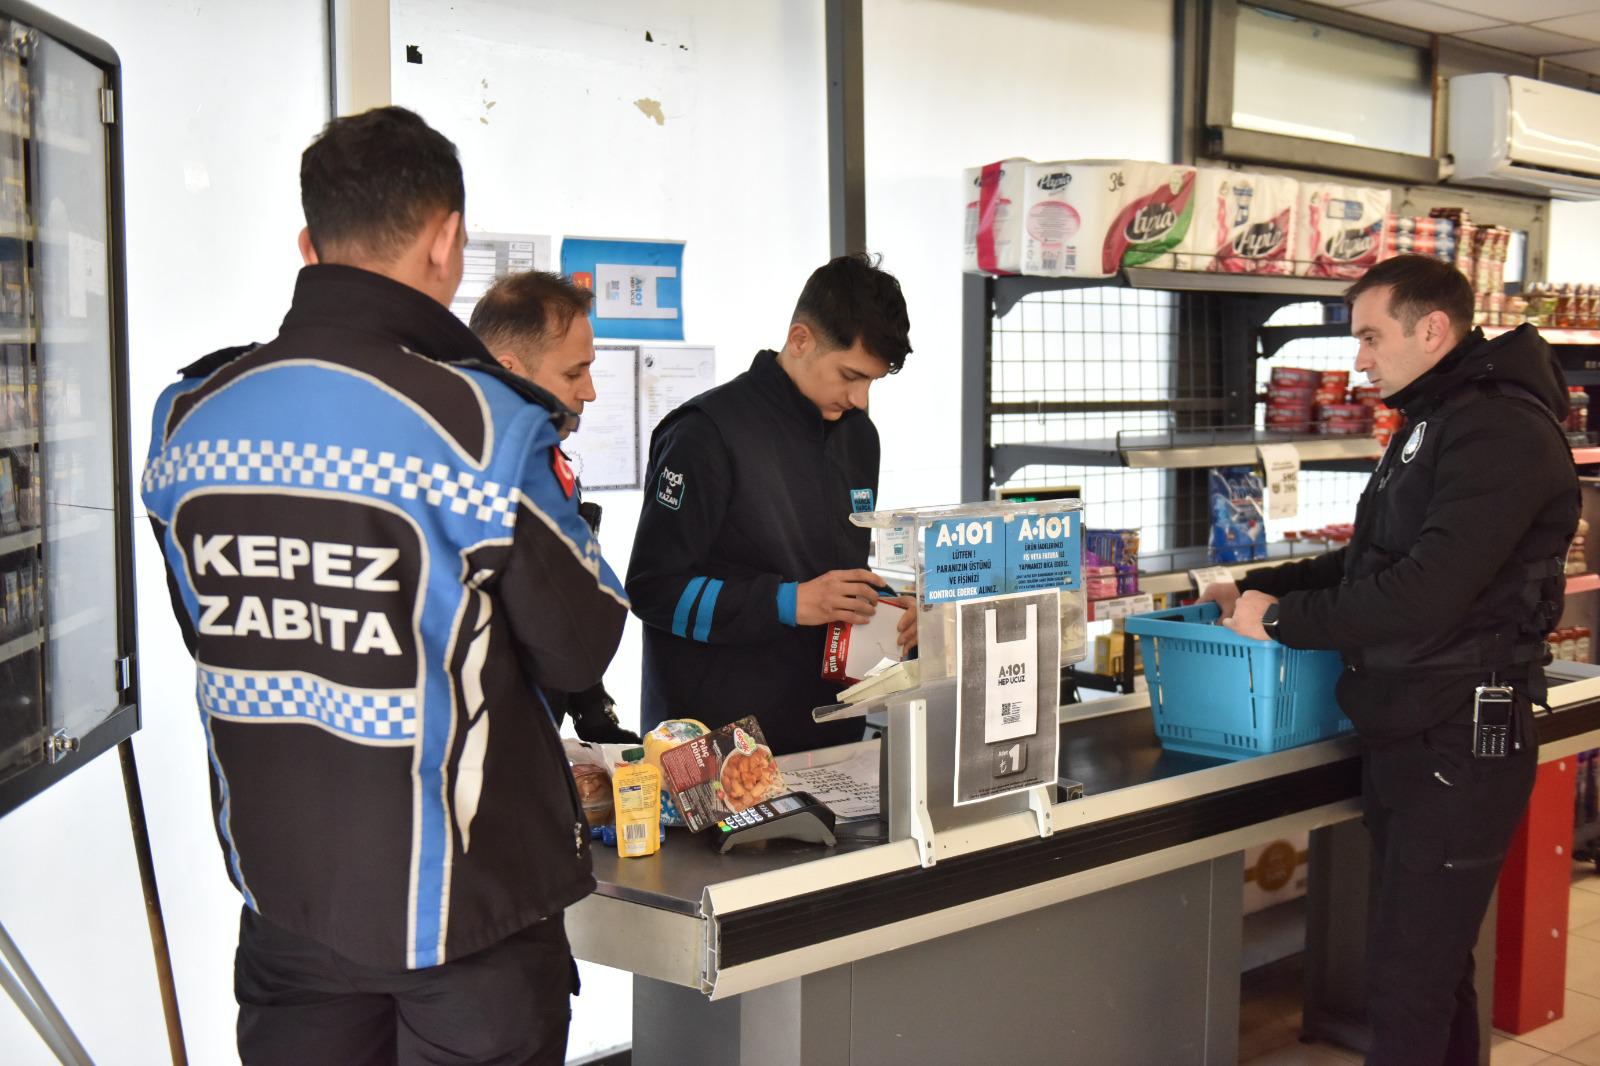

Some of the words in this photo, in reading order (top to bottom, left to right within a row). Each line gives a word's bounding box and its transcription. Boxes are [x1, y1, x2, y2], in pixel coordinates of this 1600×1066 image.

[952, 549, 972, 560] LÜTFEN
[193, 533, 400, 592] KEPEZ
[936, 563, 968, 574] PARANIZIN
[969, 559, 992, 571] ÜSTÜNÜ
[949, 576, 957, 585] VE
[929, 589, 956, 600] KONTROL
[957, 586, 978, 598] EDEREK
[198, 594, 403, 657] ZABITA
[997, 677, 1010, 686] HEP
[1010, 675, 1025, 684] UCUZ
[690, 741, 705, 768] Döner
